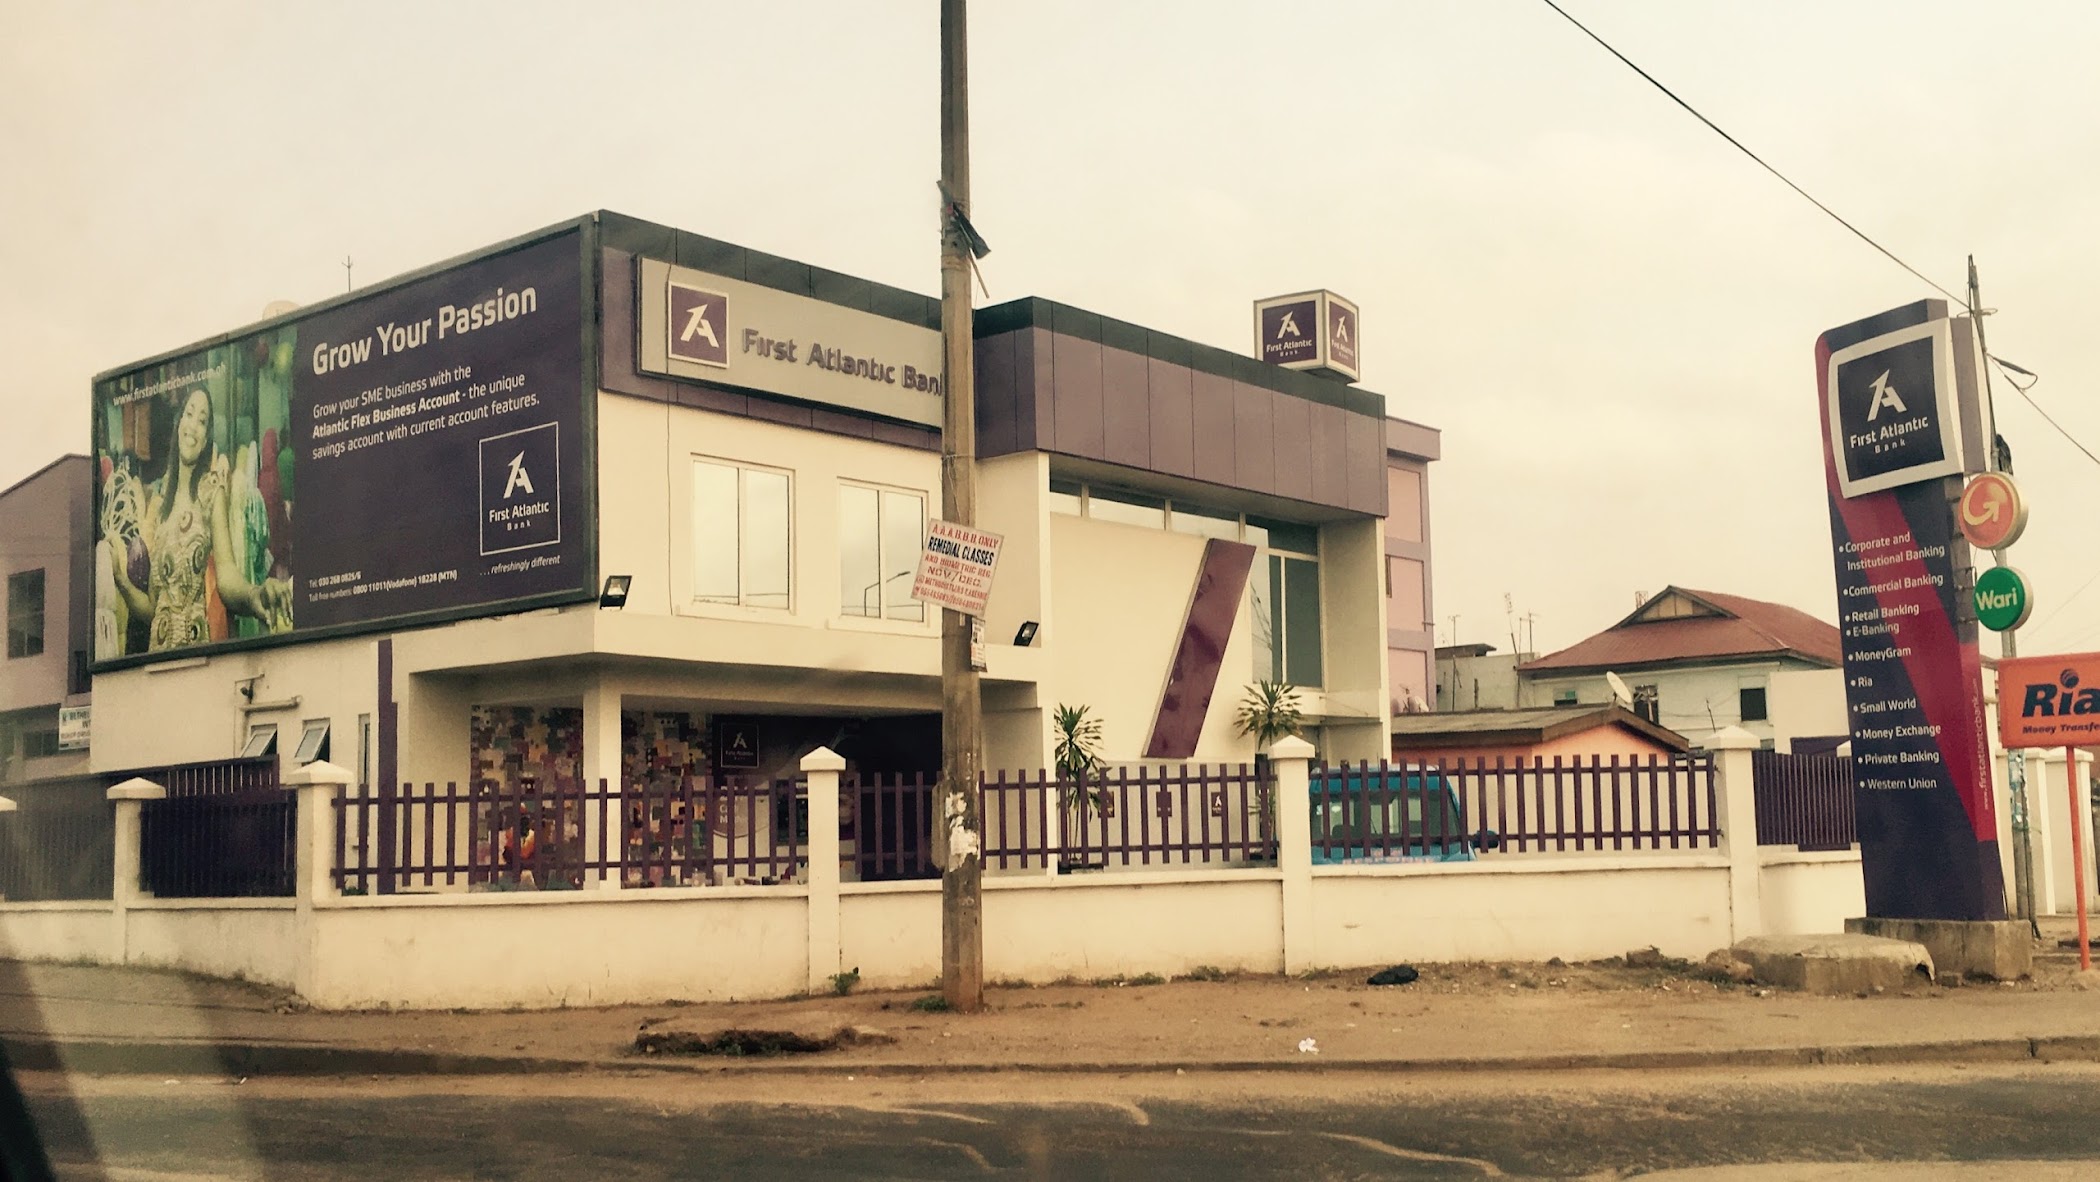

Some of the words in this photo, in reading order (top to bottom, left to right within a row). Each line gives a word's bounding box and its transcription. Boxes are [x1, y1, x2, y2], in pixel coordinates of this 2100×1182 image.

[313, 337, 372, 375] Grow
[376, 317, 432, 356] Your
[438, 287, 537, 339] Passion
[1266, 343, 1282, 352] First
[1284, 339, 1312, 350] Atlantic
[742, 327, 798, 363] First
[807, 342, 896, 385] Atlantic
[901, 364, 943, 396] Ban
[313, 401, 338, 420] Grow
[339, 396, 359, 415] your
[361, 387, 383, 406] SME
[385, 376, 427, 400] business
[429, 369, 452, 389] with
[454, 365, 472, 382] the
[312, 417, 349, 439] Atlantic
[351, 412, 371, 430] Flex
[373, 401, 416, 424] Business
[418, 390, 460, 413] Account
[468, 382, 486, 400] the
[489, 372, 526, 396] unique
[312, 438, 346, 460] savings
[347, 430, 384, 452] account
[386, 422, 408, 442] with
[410, 413, 446, 436] current
[448, 403, 489, 427] account
[491, 392, 540, 416] features.
[1850, 430, 1877, 449] First
[1880, 416, 1929, 440] Atlantic
[1874, 438, 1906, 454] Bank
[489, 508, 510, 523] First
[512, 501, 550, 519] Atlantic
[507, 519, 531, 531] Bank
[978, 535, 999, 549] ONLY
[1845, 537, 1890, 553] Corporate
[1893, 531, 1911, 544] and
[925, 554, 939, 565] AND
[928, 536, 960, 558] REMEDIAL
[962, 545, 995, 566] CLASSES
[1847, 551, 1903, 571] Institutional
[1906, 545, 1945, 561] Banking
[531, 555, 560, 569] different
[1848, 579, 1902, 597] Commercial
[1904, 574, 1943, 589] Banking
[1975, 587, 2018, 611] Wari
[1852, 609, 1879, 622] Retail
[1881, 604, 1919, 619] Banking
[1853, 623, 1900, 638] E-Banking
[1855, 647, 1912, 662] MoneyGram
[1858, 676, 1873, 687] Ria
[2022, 668, 2100, 717] Ria
[1860, 701, 1886, 714] Small
[1888, 698, 1917, 711] World
[1862, 728, 1893, 740] Money
[1896, 724, 1941, 737] Exchange
[2022, 726, 2057, 735] Money
[2060, 722, 2100, 732] Transfe
[1865, 752, 1898, 765] Private
[1900, 750, 1940, 763] Banking
[1867, 778, 1906, 790] Western
[1908, 777, 1937, 790] Union
